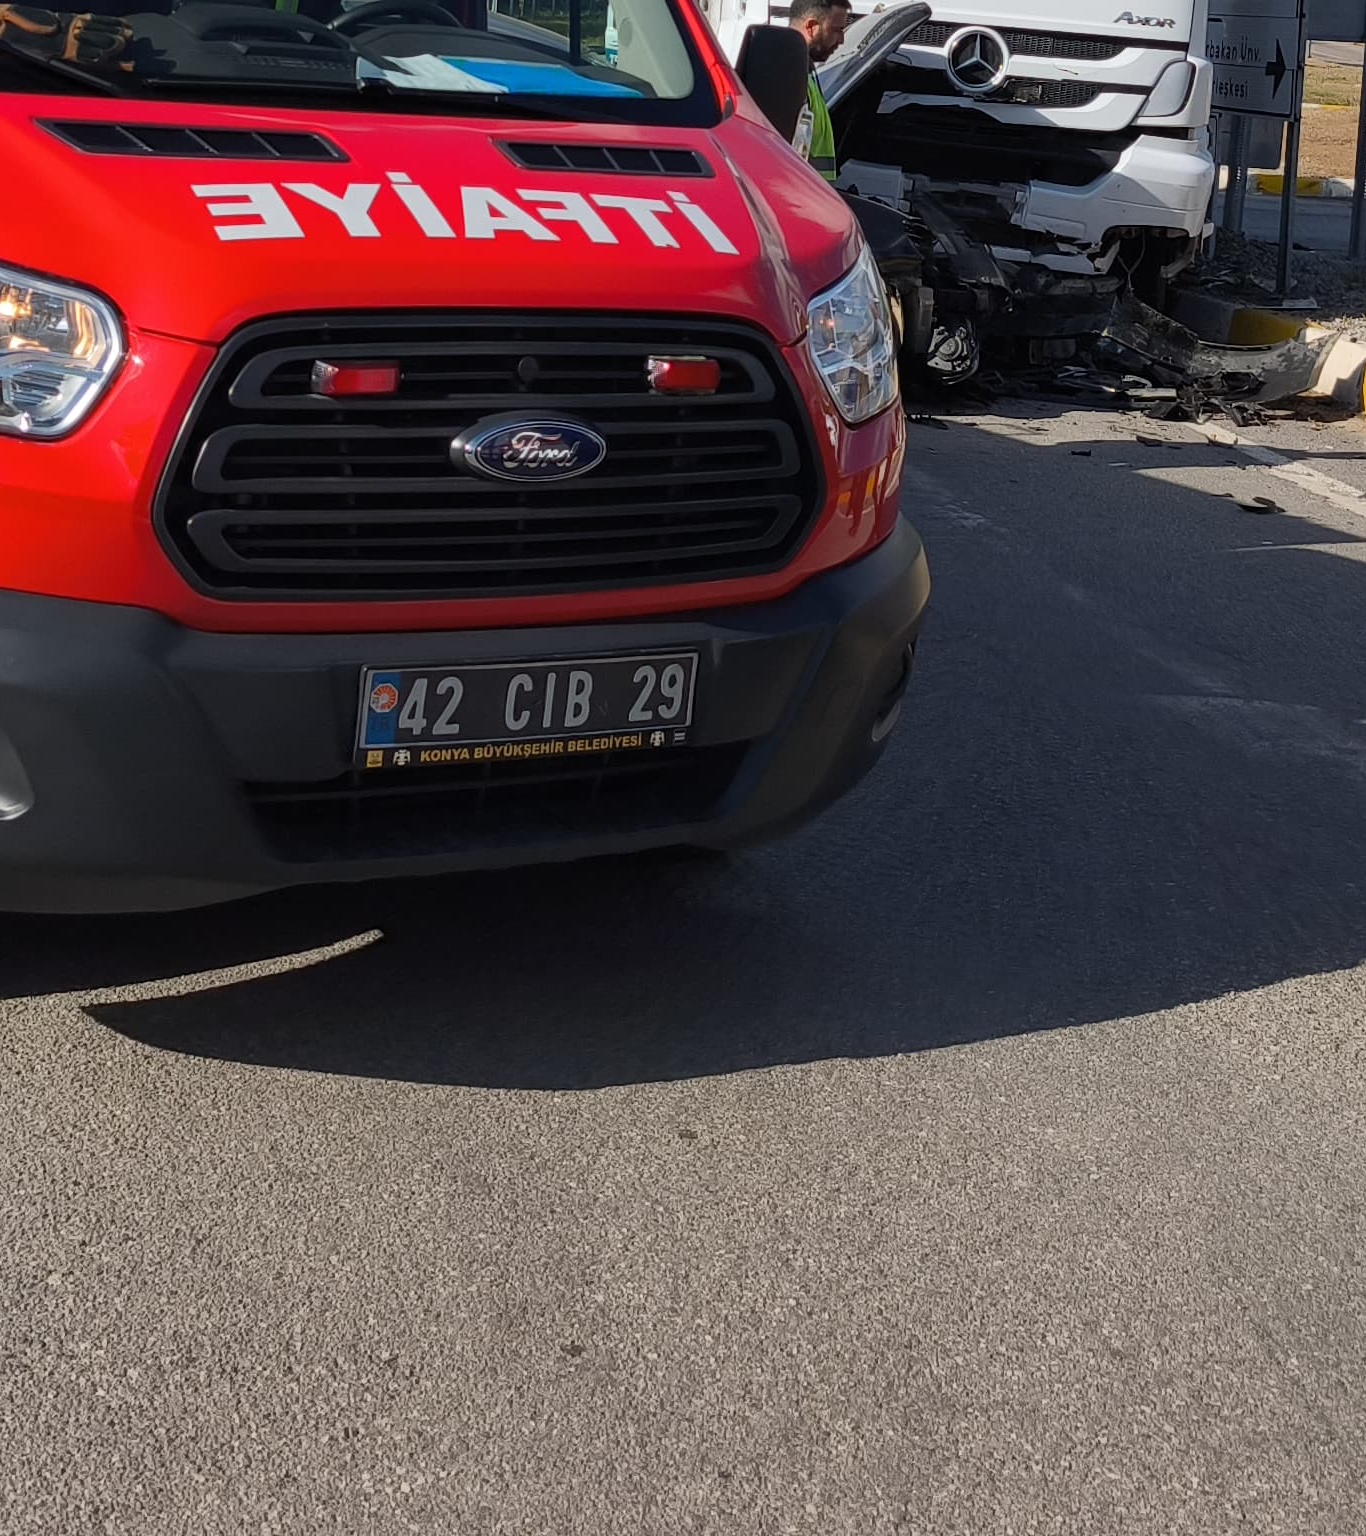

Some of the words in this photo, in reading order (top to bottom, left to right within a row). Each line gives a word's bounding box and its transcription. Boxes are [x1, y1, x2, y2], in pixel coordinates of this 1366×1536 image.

[503, 431, 581, 468] Ford
[398, 676, 464, 735] 42
[505, 670, 593, 731] CIB
[628, 663, 685, 722] 29
[420, 748, 470, 762] KONYA
[474, 738, 564, 759] BÜYÜKŞEHİR
[567, 732, 642, 752] BELEDİYESİ
